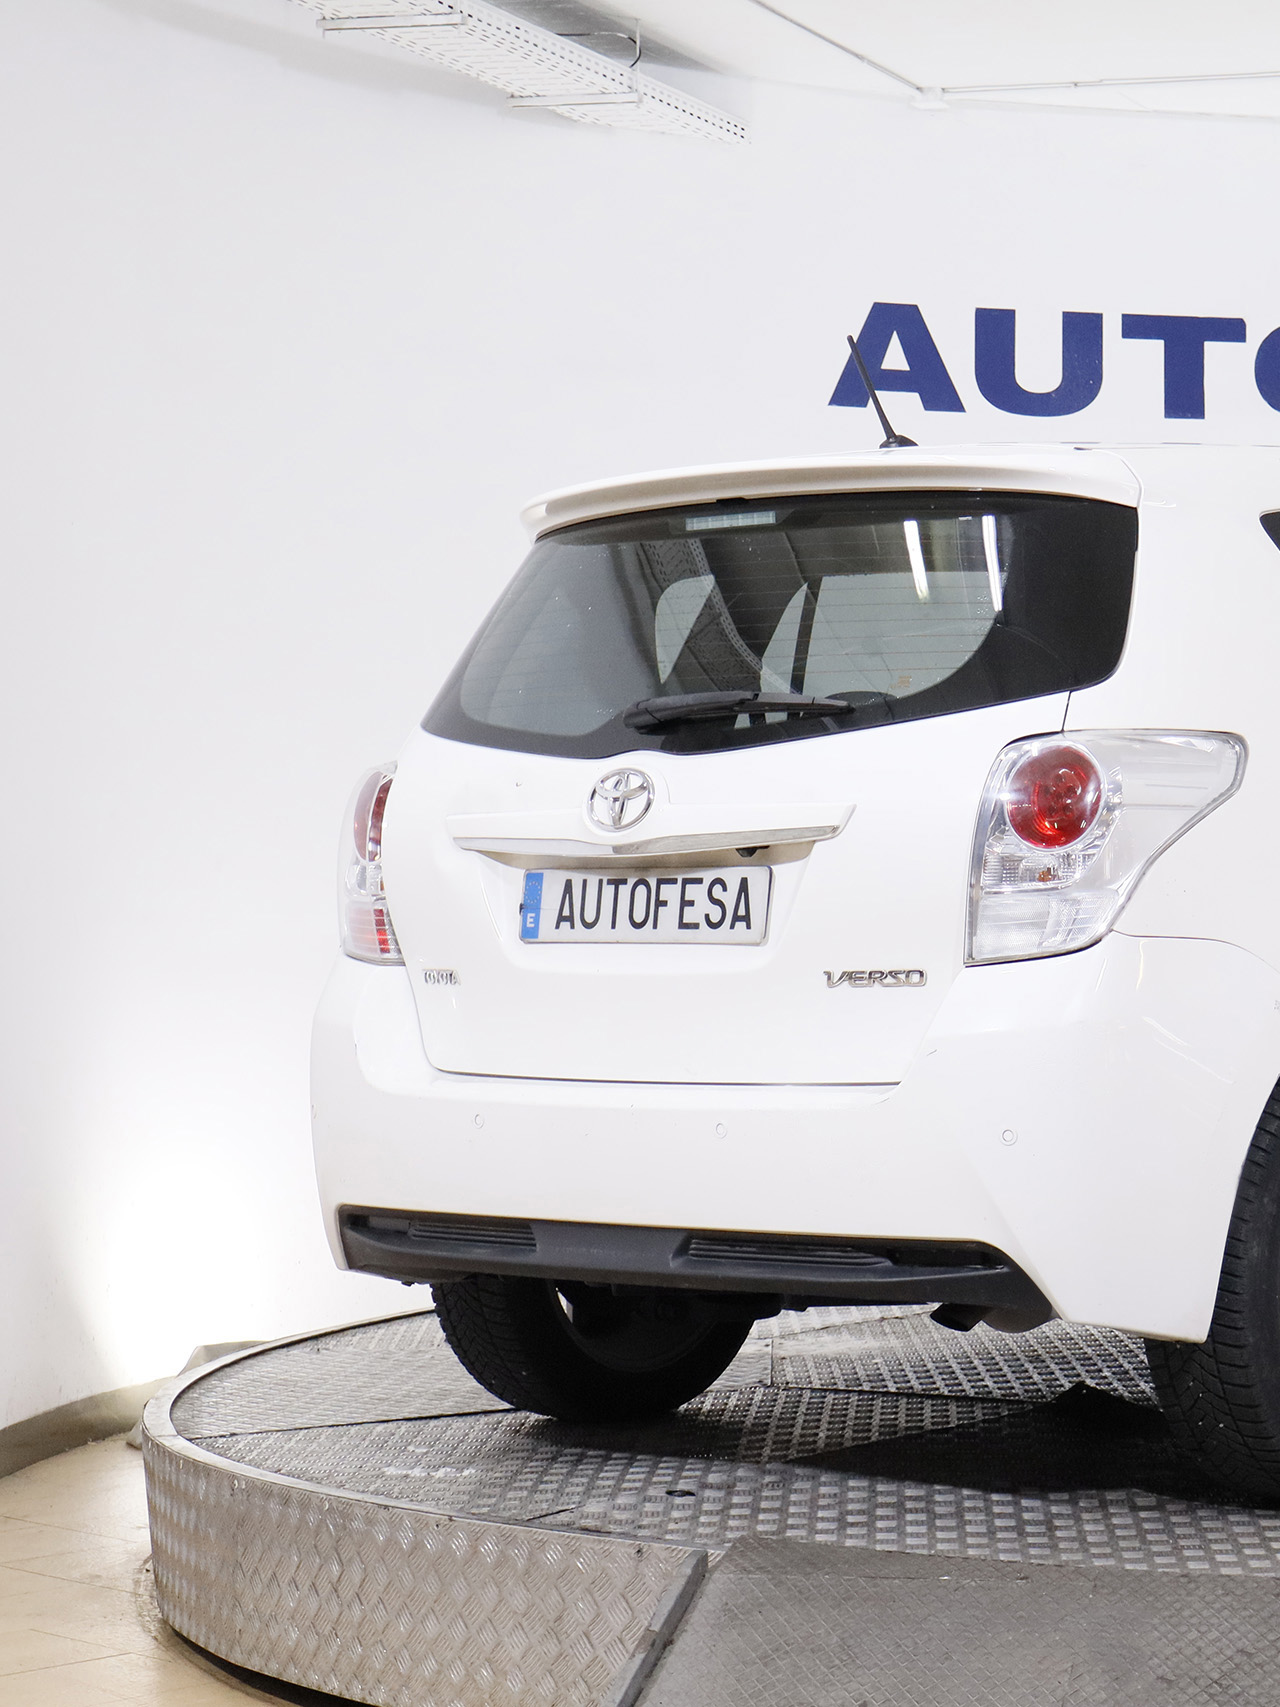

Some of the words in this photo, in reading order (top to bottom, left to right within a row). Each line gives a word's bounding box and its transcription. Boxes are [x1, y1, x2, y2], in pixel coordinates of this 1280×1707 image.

[554, 876, 752, 930] AUTOFESA
[526, 912, 536, 928] E
[823, 970, 927, 988] VERSO
